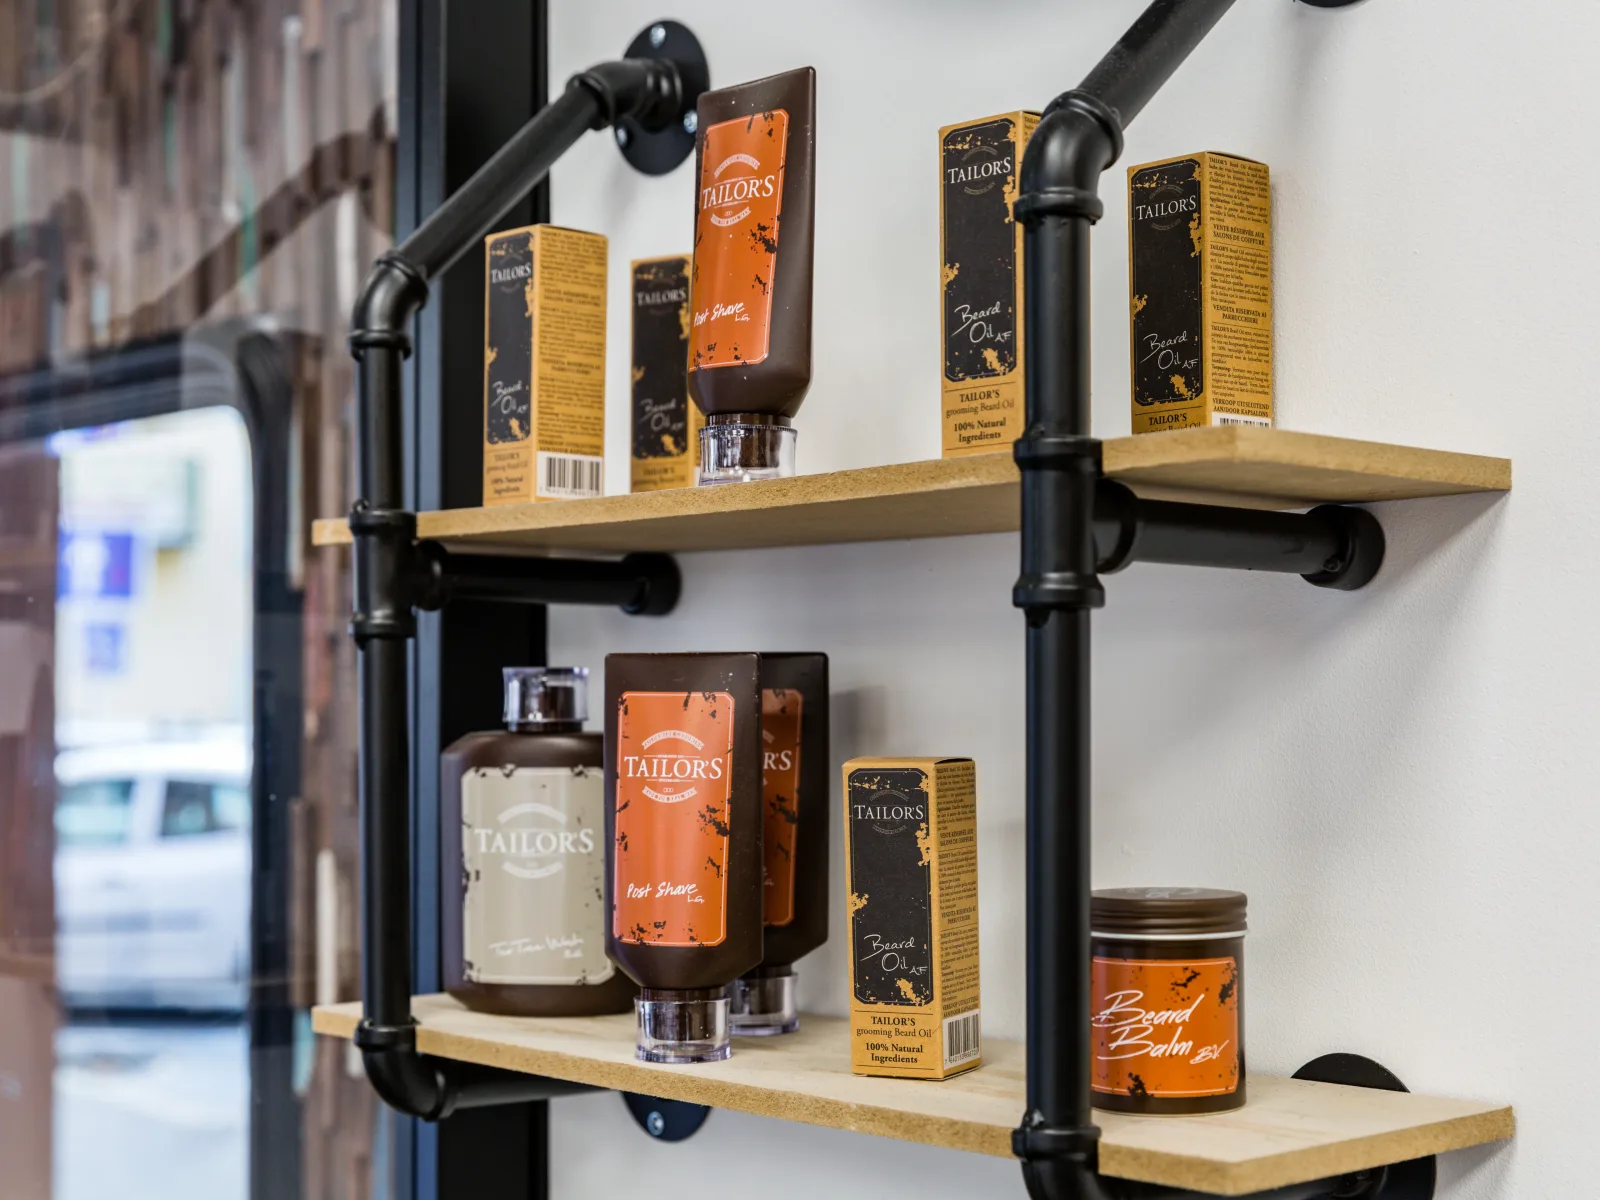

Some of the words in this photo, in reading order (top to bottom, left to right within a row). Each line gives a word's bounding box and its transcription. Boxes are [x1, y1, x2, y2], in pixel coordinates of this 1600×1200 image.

[948, 156, 1012, 184] TAILOR'S
[702, 175, 776, 209] TAILOR'S
[1136, 195, 1197, 221] TAILOR'S
[710, 302, 745, 321] Shave
[951, 301, 1002, 337] Beard
[969, 321, 994, 343] Oil
[1140, 330, 1188, 363] Beard
[1157, 349, 1182, 370] Oil
[959, 388, 1001, 403] TAILOR'S
[945, 404, 979, 419] grooming
[980, 400, 1001, 412] Beard
[1002, 398, 1016, 409] Oil
[953, 422, 976, 432] 100%
[976, 416, 1007, 429] Natural
[1148, 412, 1187, 426] TAILOR'S
[958, 431, 1002, 444] Ingredients
[623, 755, 723, 780] TAILOR'S
[853, 804, 924, 820] TAILOR'S
[627, 882, 652, 898] Post
[655, 881, 698, 898] Shave
[860, 934, 917, 961] Beard
[881, 952, 909, 972] Oil
[1091, 989, 1205, 1028] Beard
[871, 1016, 917, 1026] TAILOR'S
[856, 1027, 893, 1039] grooming
[894, 1028, 917, 1037] Beard
[918, 1028, 932, 1038] Oil
[1097, 1023, 1193, 1061] Balm
[865, 1042, 889, 1052] 100%
[891, 1043, 924, 1053] Natural
[871, 1053, 919, 1065] Ingredients
